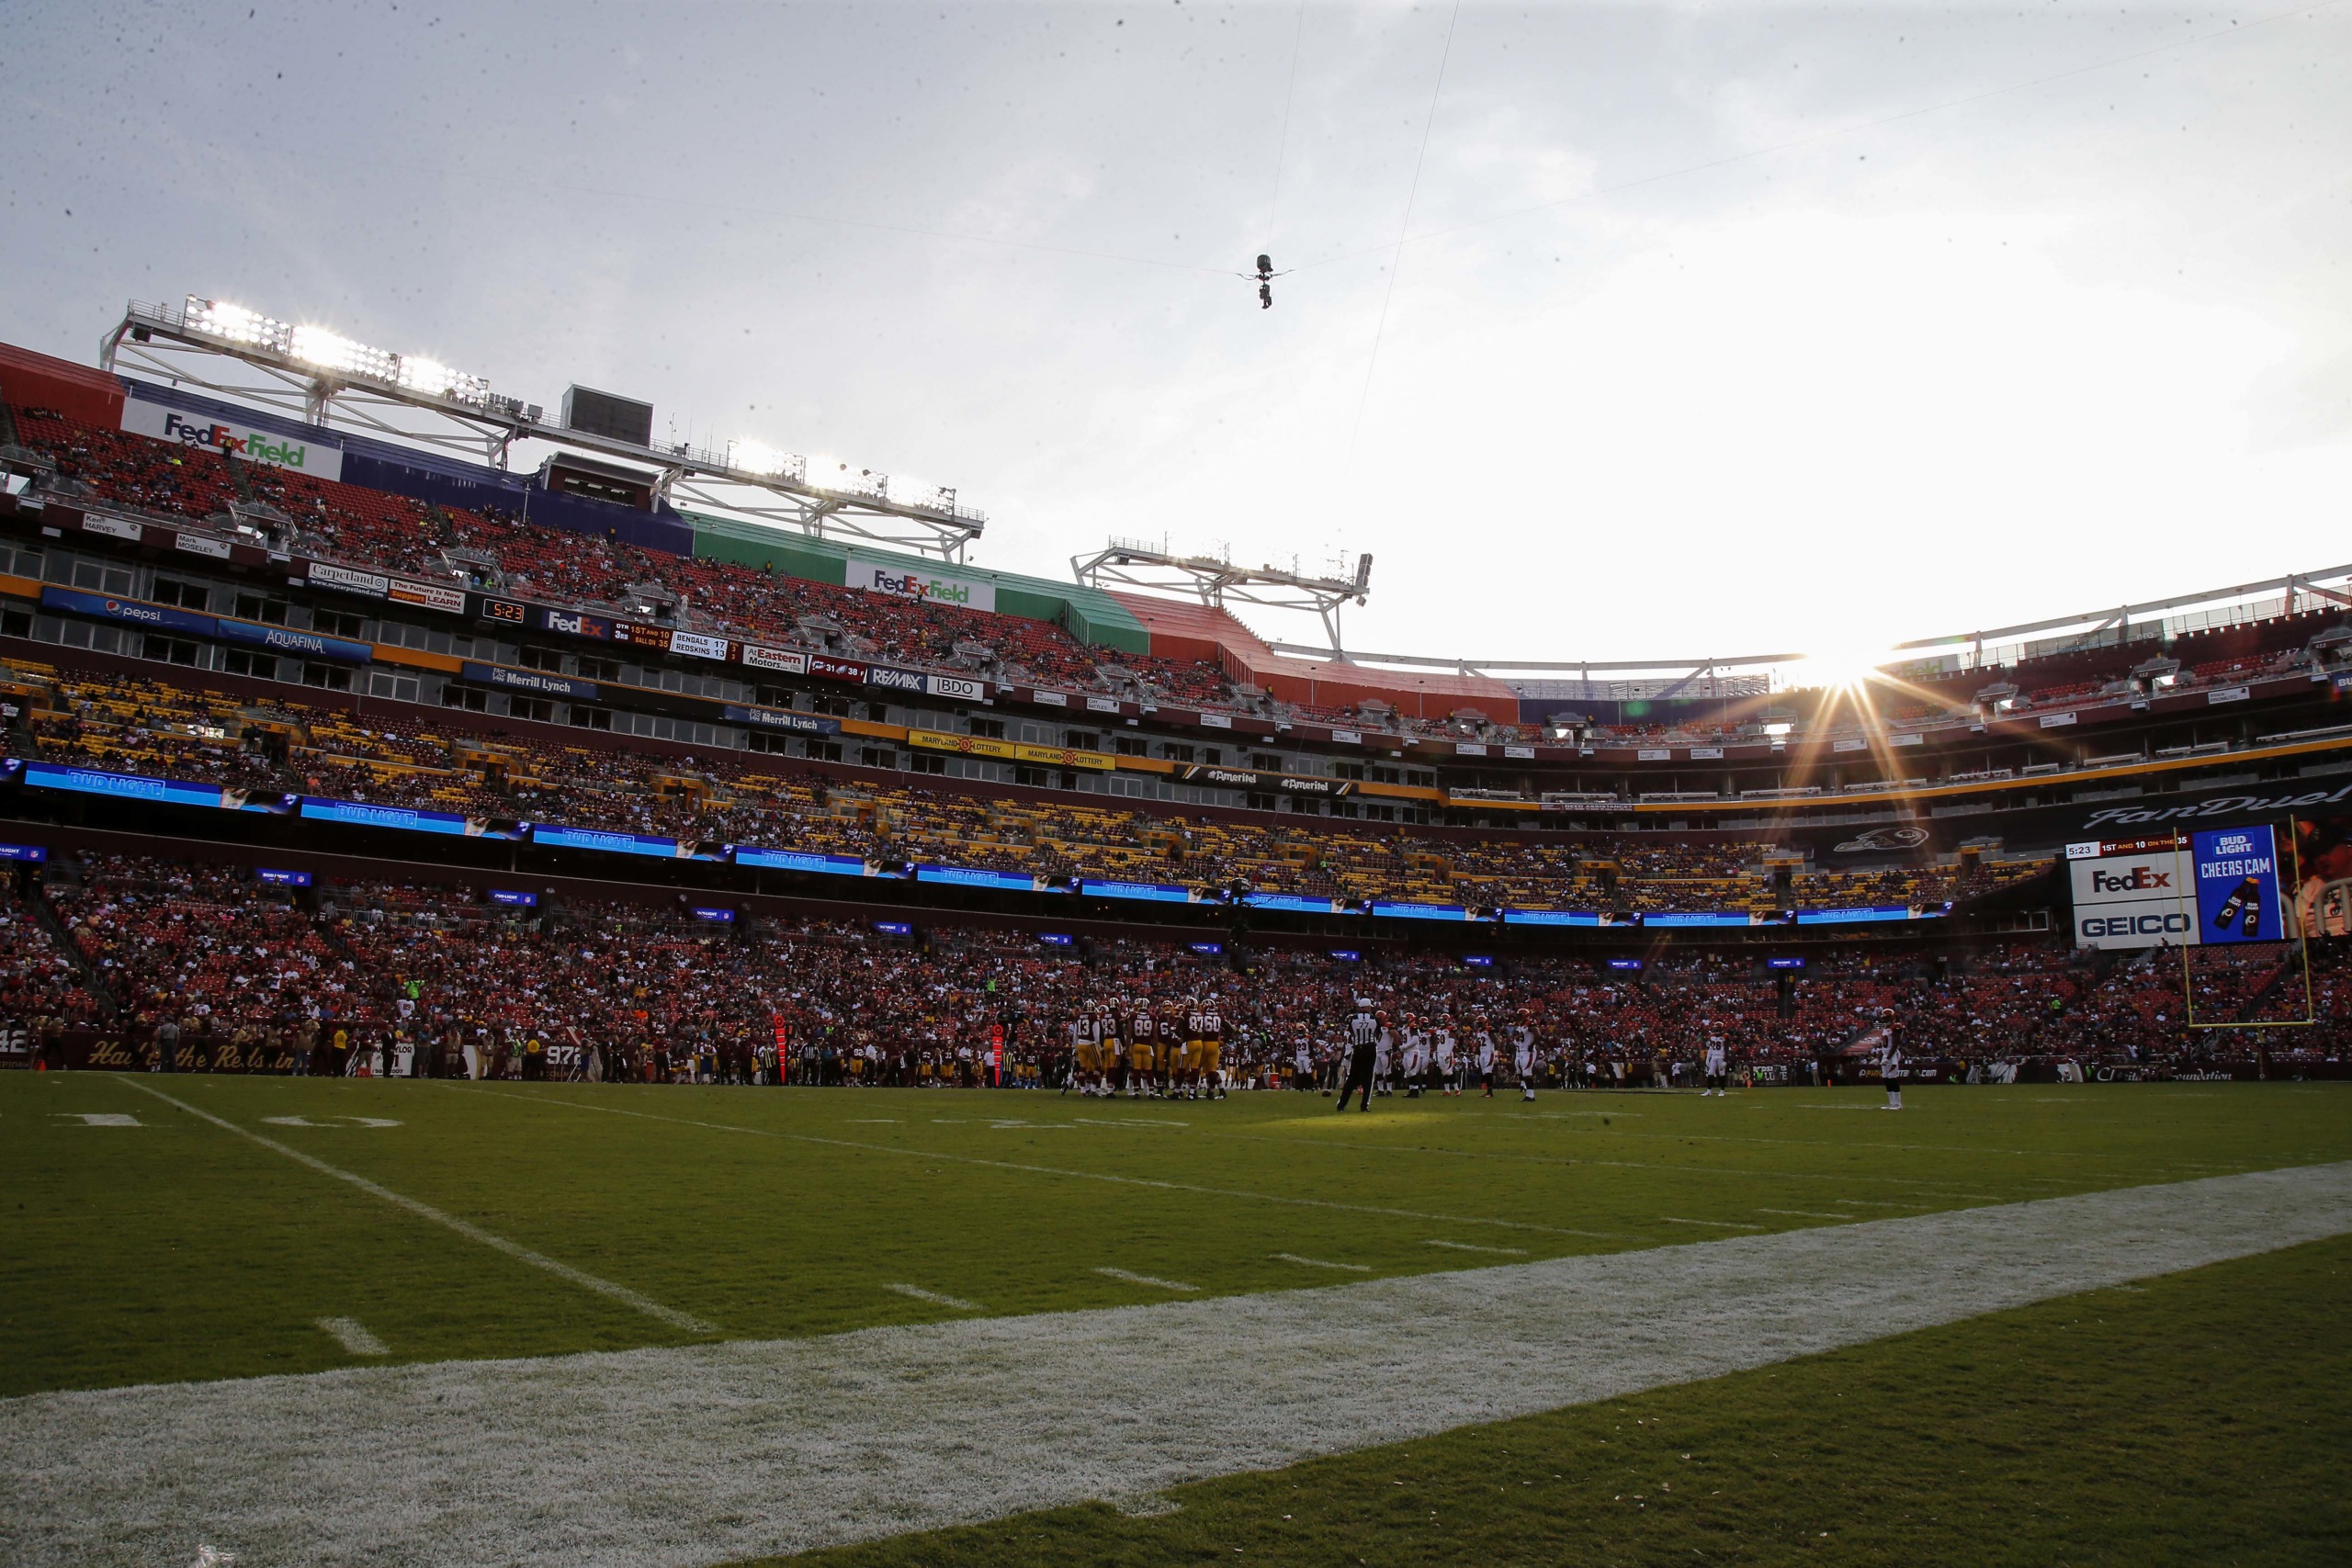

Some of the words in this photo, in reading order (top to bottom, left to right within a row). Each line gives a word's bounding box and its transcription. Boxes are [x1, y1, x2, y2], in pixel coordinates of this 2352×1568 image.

[164, 413, 306, 468] FedExField
[85, 522, 117, 534] HARVEY
[178, 542, 213, 553] MOSELEY
[179, 536, 196, 544] Mark
[313, 563, 374, 586] Carpetland
[311, 579, 383, 598] www.mycarpetland.com
[394, 581, 408, 590] The
[410, 584, 434, 594] Future
[445, 590, 461, 599] Now
[875, 570, 969, 604] FedExField
[392, 589, 425, 602] Support
[427, 595, 461, 607] LEARN
[123, 607, 161, 621] pepsi
[427, 601, 460, 612] Foundation
[494, 604, 522, 620] 5:23
[548, 611, 604, 637] FedEx
[631, 626, 647, 635] 1ST
[266, 630, 323, 653] AQUAFINA
[677, 634, 708, 646] BENGALS
[676, 644, 710, 655] REDSKINS
[748, 649, 757, 657] At
[757, 649, 801, 664] Eastern
[749, 657, 788, 671] Motors...
[826, 663, 835, 672] 31
[847, 667, 858, 676] 38
[507, 672, 540, 687] Merrill
[542, 678, 571, 694] Lynch
[873, 669, 921, 691] RE/MAX
[942, 680, 973, 694] BDO
[763, 713, 791, 727] Merrill
[793, 717, 818, 730] Lynch
[922, 736, 957, 747] MARYLAND
[974, 741, 1001, 753] LOTTERY
[1028, 750, 1062, 761] MARYLAND
[1076, 754, 1103, 765] LOTTERY
[69, 772, 107, 788] BUD
[1216, 770, 1257, 784] Ameritel
[1288, 778, 1329, 791] Ameritel
[338, 805, 368, 818] BUD
[2083, 783, 2352, 829] FanDuel
[565, 830, 590, 844] BUD
[2220, 835, 2246, 847] BUD
[2068, 846, 2091, 855] 5:23
[2135, 840, 2145, 849] 10
[2177, 837, 2188, 845] 35
[2215, 841, 2253, 855] LIGHT
[764, 852, 787, 863] BUD
[2201, 859, 2243, 878] CHEERS
[2245, 857, 2270, 874] CAM
[2092, 866, 2171, 893] FedEx
[2081, 913, 2191, 938] GEICO
[1077, 1020, 1090, 1036] 13
[1134, 1021, 1152, 1037] 89
[1189, 1016, 1204, 1032] 87
[1204, 1016, 1221, 1032] 60
[1296, 1043, 1306, 1052] 23
